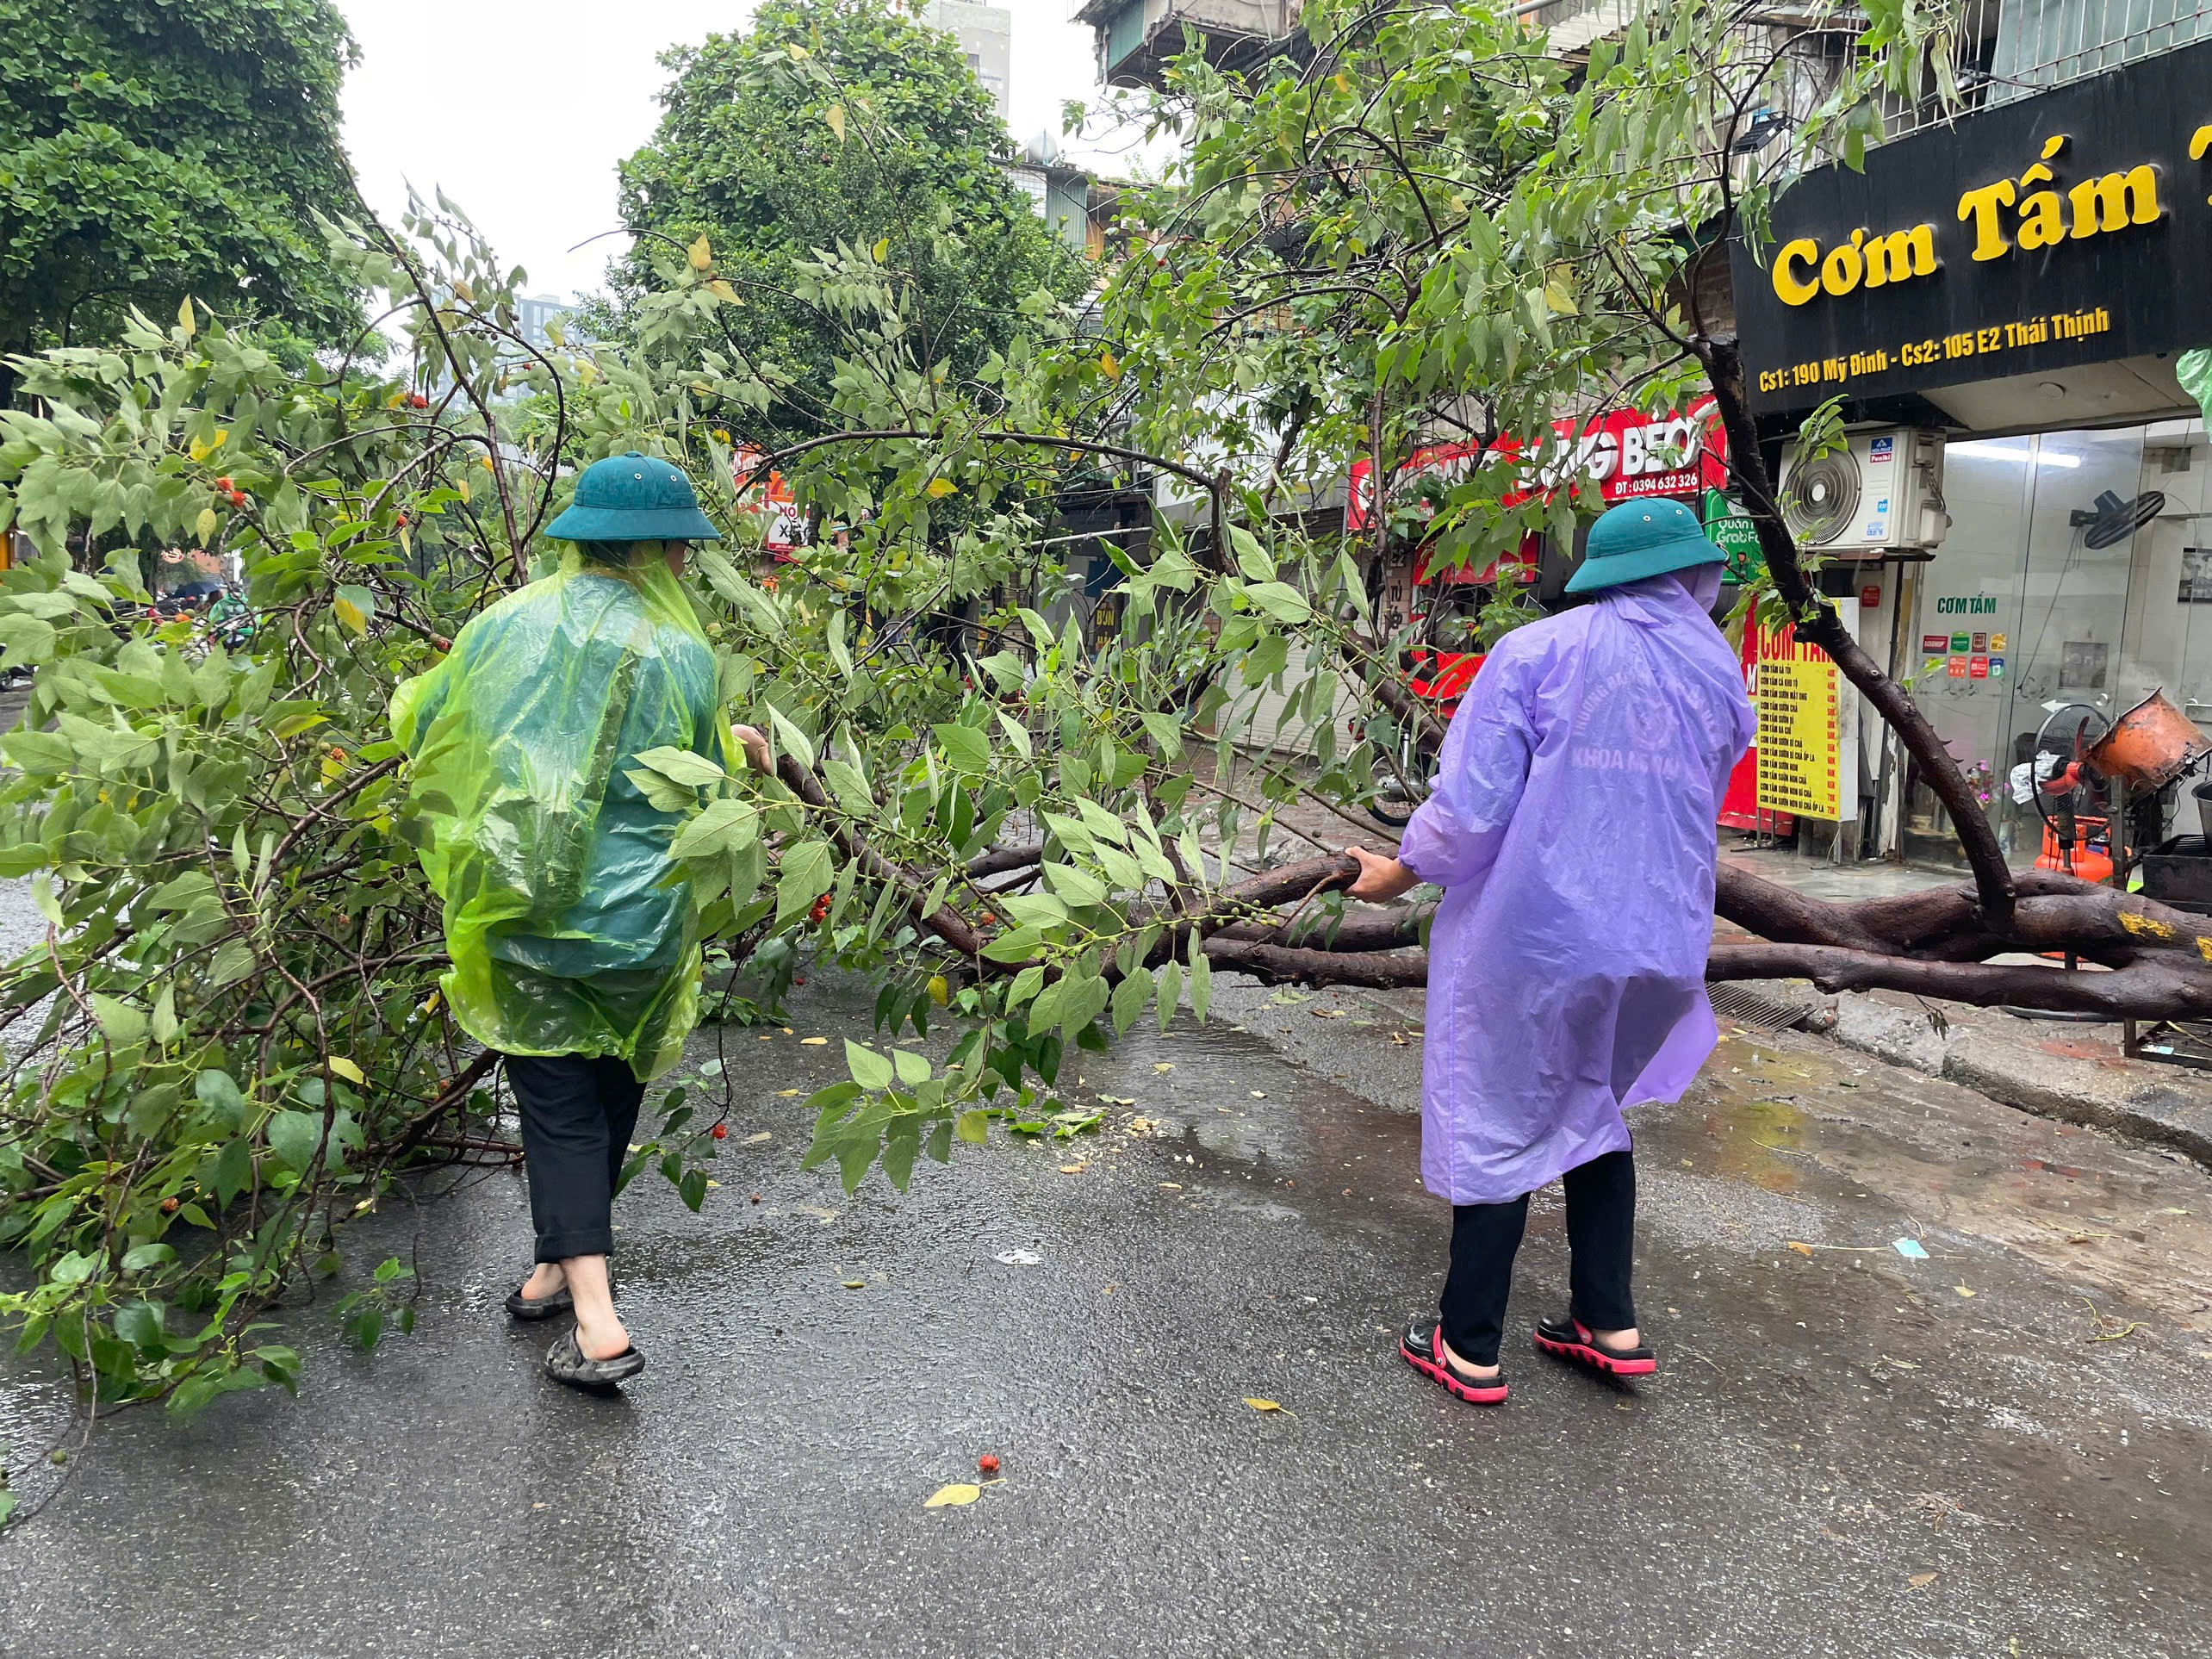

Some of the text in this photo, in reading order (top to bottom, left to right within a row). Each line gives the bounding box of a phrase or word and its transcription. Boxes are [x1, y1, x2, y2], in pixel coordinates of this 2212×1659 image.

[1771, 222, 1938, 307] Cơm
[1957, 134, 2161, 262] Tấm
[1759, 369, 1789, 393] Cs1:
[1792, 361, 1820, 386] 190
[1823, 356, 1848, 383] Mỹ
[1849, 349, 1887, 376] Đình
[1901, 340, 1942, 367] Cs2:
[1942, 331, 1974, 360] 105
[1977, 326, 2002, 354] E2
[2004, 315, 2048, 348] Thái
[2051, 306, 2110, 343] Thịnh
[1657, 475, 1676, 491] 632
[1677, 472, 1698, 488] 326
[1936, 590, 1998, 614] CƠM TẤM
